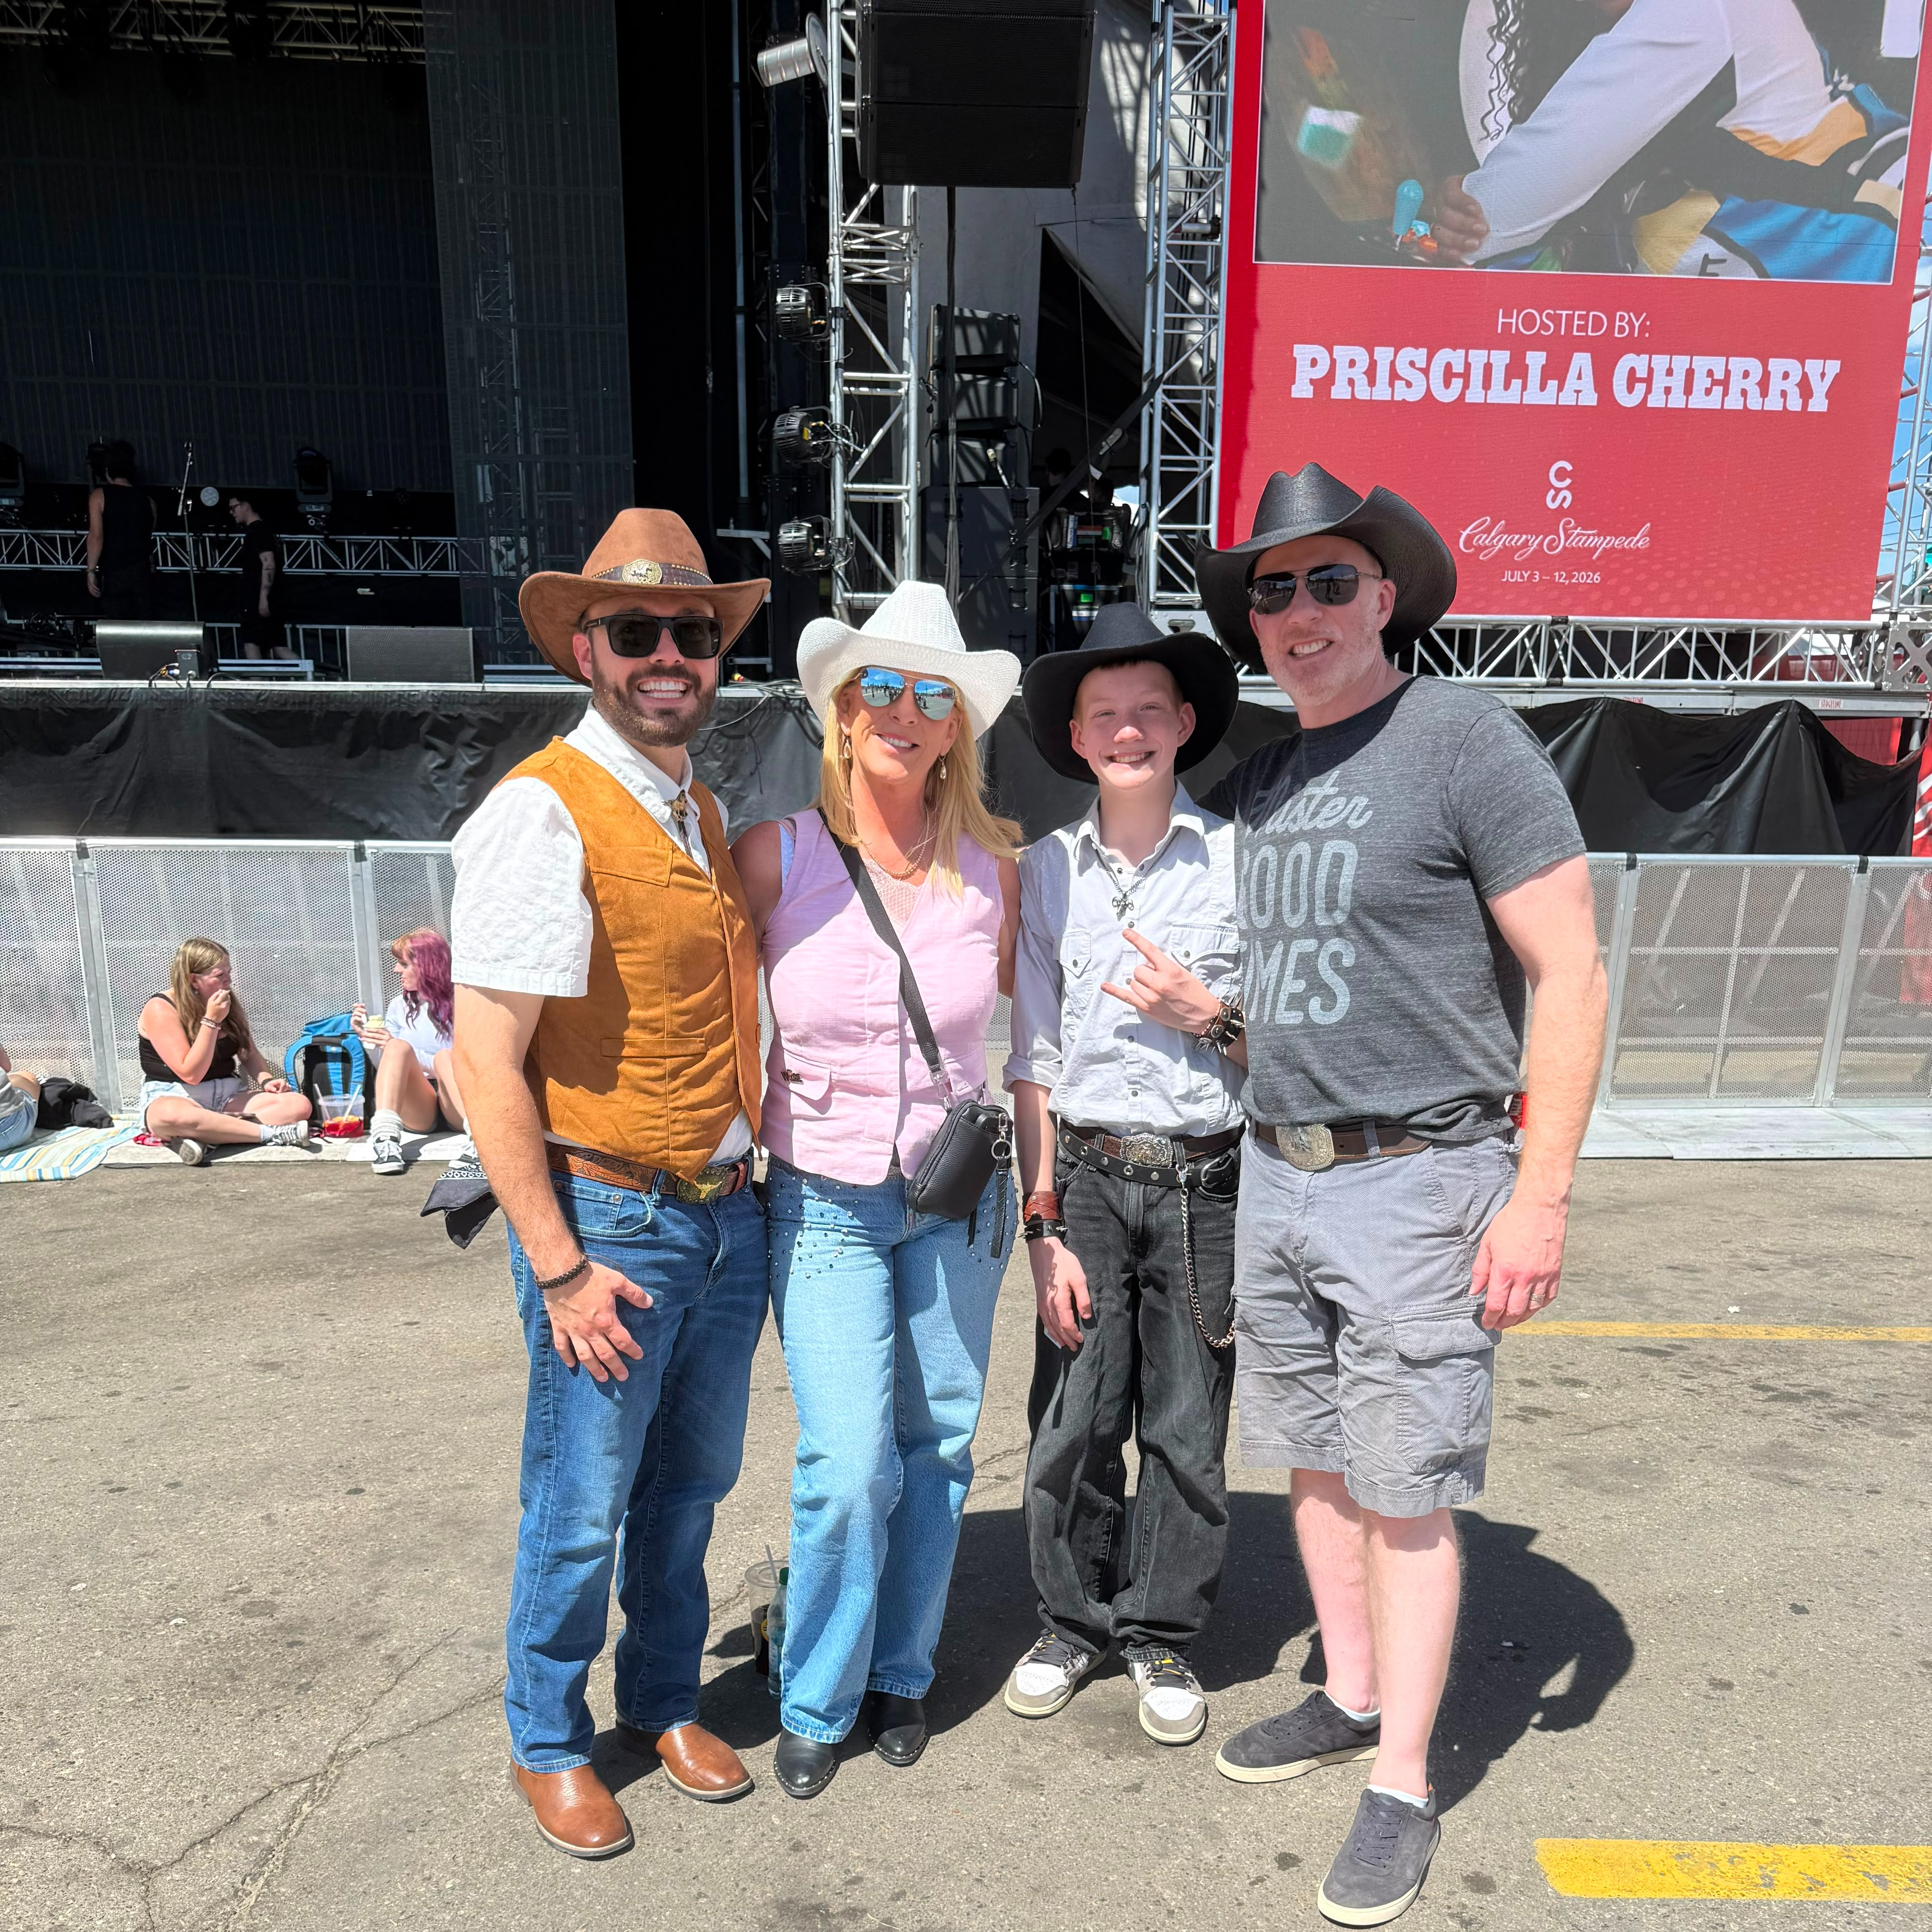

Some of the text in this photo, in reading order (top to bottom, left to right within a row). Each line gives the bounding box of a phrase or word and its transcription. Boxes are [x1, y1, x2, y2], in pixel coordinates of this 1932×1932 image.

[1497, 308, 1651, 338] HOSTED BY:
[1290, 344, 1842, 413] PRISCILLA CHERRY
[1460, 516, 1651, 561] Calgary Stampede
[1501, 570, 1531, 583] JULY
[1532, 571, 1540, 583] 3
[1553, 572, 1569, 585] 12,
[1571, 572, 1601, 584] 2026
[1239, 938, 1356, 1025] IMES
